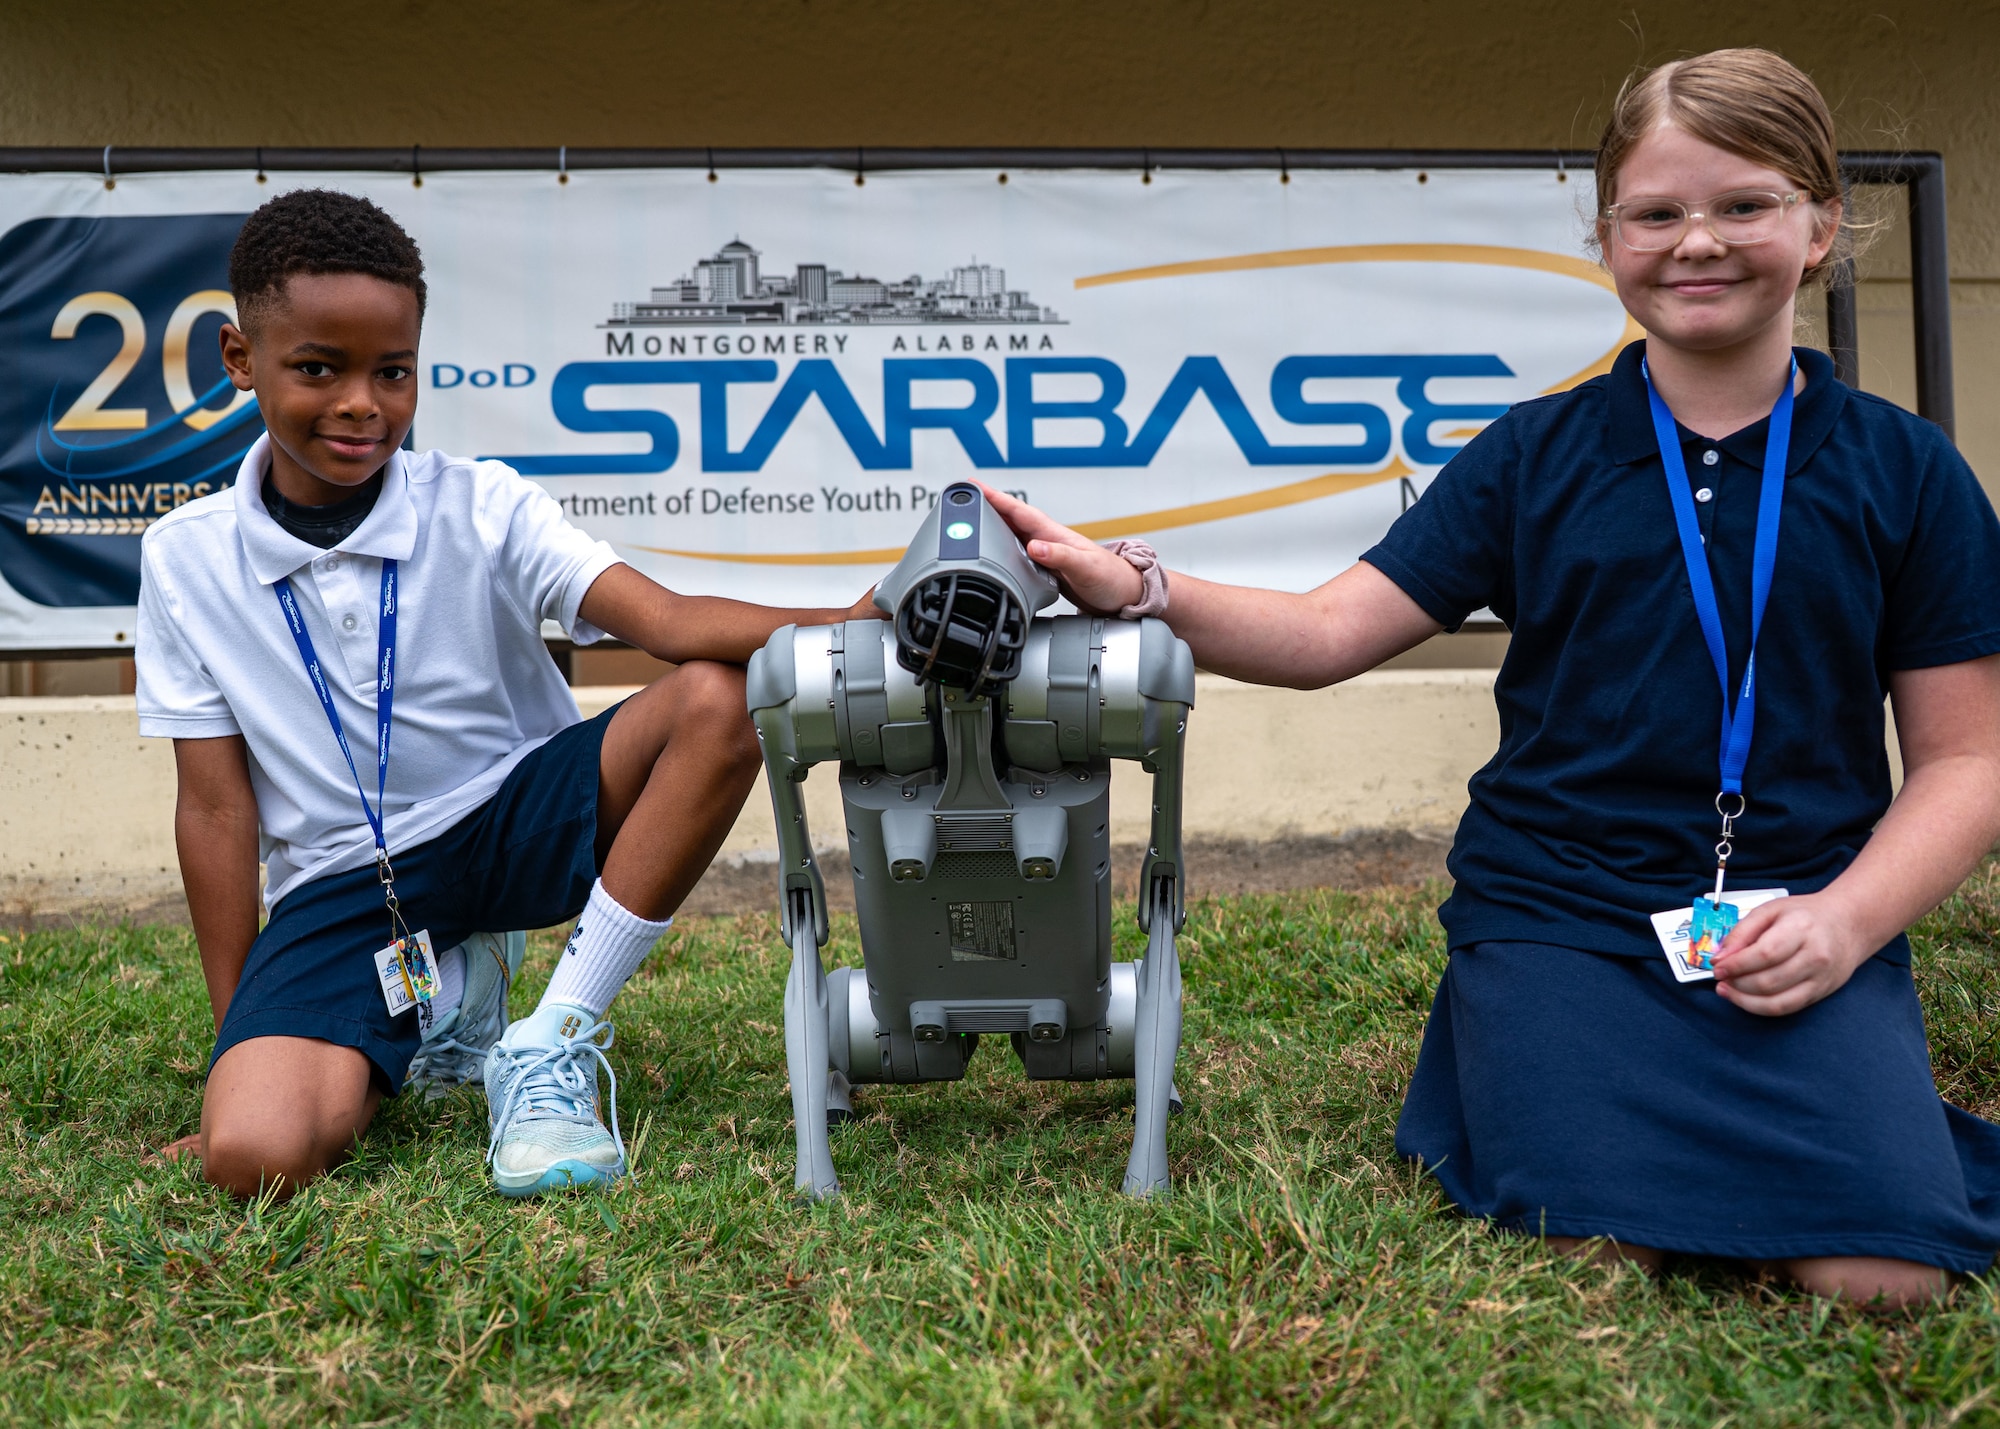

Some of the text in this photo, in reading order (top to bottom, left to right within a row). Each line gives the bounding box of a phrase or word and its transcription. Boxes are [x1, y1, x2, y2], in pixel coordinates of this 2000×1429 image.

[51, 289, 256, 432] 20
[606, 332, 1053, 355] MONTGOMERY ALABAMA
[431, 354, 1517, 476] DoD STARBASE
[32, 481, 229, 515] ANNIVERS
[559, 492, 657, 516] rtment
[665, 487, 694, 515] of
[702, 486, 814, 514] Defense
[820, 485, 902, 512] Youth
